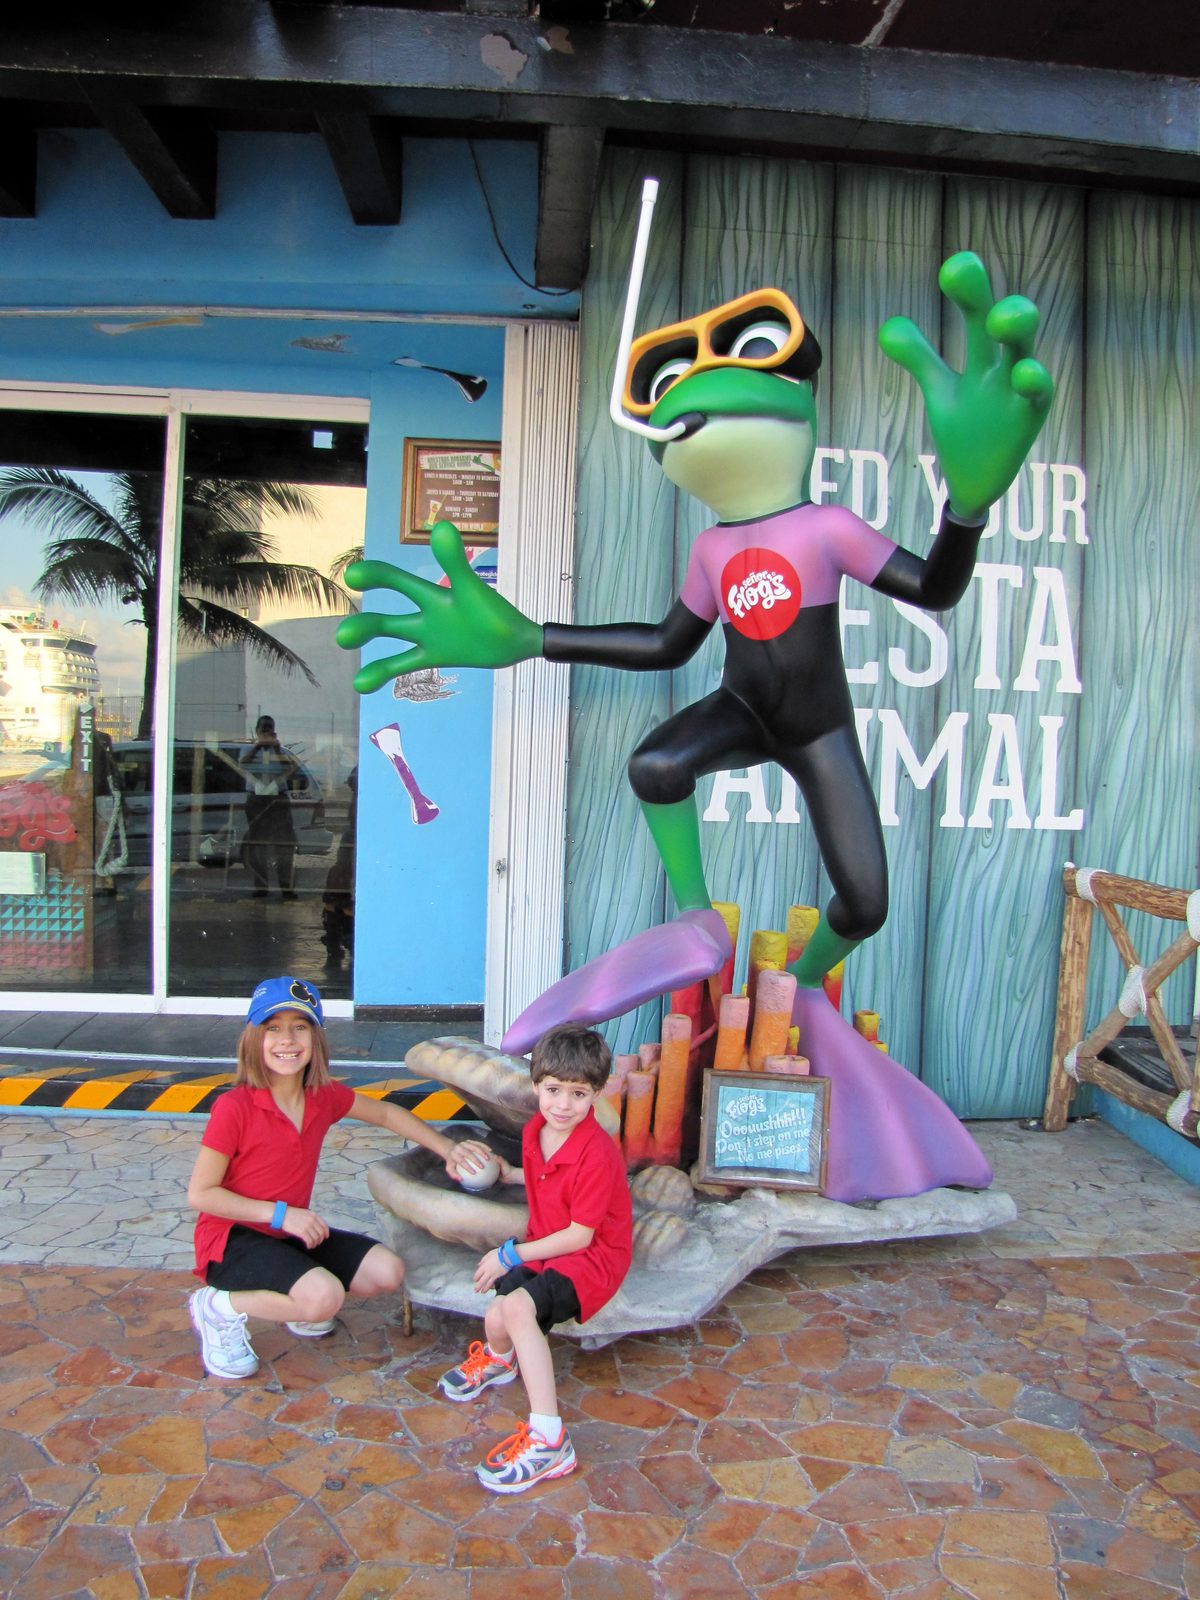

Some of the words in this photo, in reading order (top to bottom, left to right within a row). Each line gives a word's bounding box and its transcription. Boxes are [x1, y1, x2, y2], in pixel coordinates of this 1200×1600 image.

[810, 448, 889, 531] ED
[918, 455, 1089, 545] YUR
[839, 562, 1083, 693] ESTA
[80, 716, 94, 773] EXIT
[703, 708, 1084, 830] AMAL
[738, 1147, 754, 1163] No
[757, 1149, 773, 1159] me
[753, 1134, 775, 1147] step
[777, 1131, 791, 1141] on
[794, 1128, 810, 1138] me
